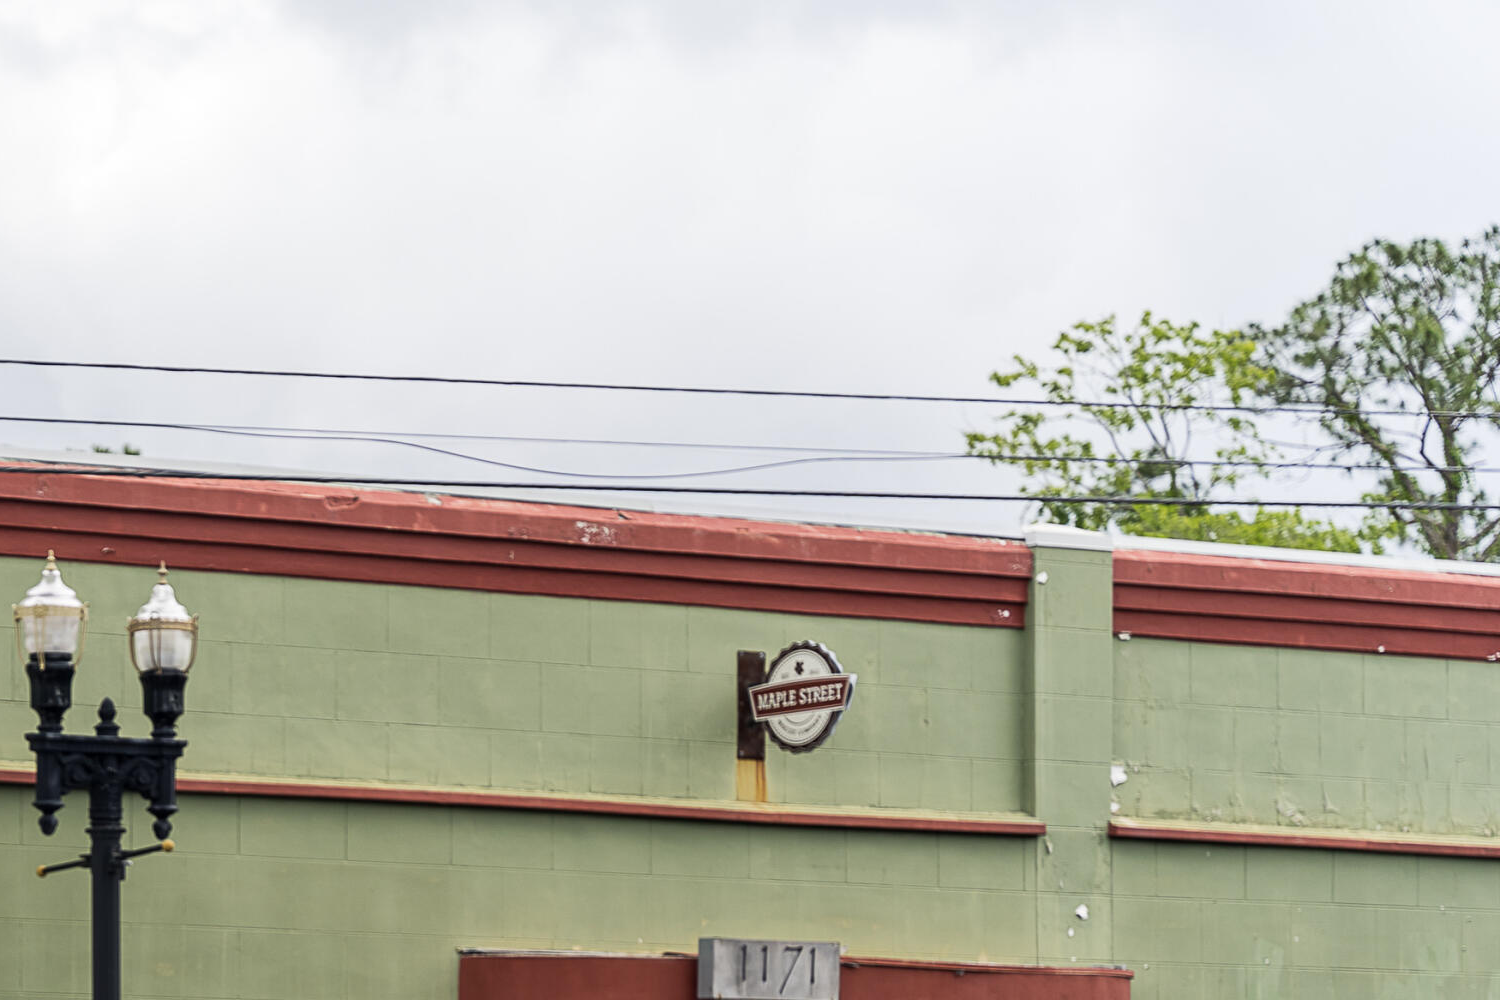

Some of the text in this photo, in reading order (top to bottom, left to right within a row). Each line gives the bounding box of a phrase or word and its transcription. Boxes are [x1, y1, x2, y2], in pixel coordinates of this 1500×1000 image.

[757, 683, 843, 710] MAPLE STREET
[741, 944, 816, 995] 1171
